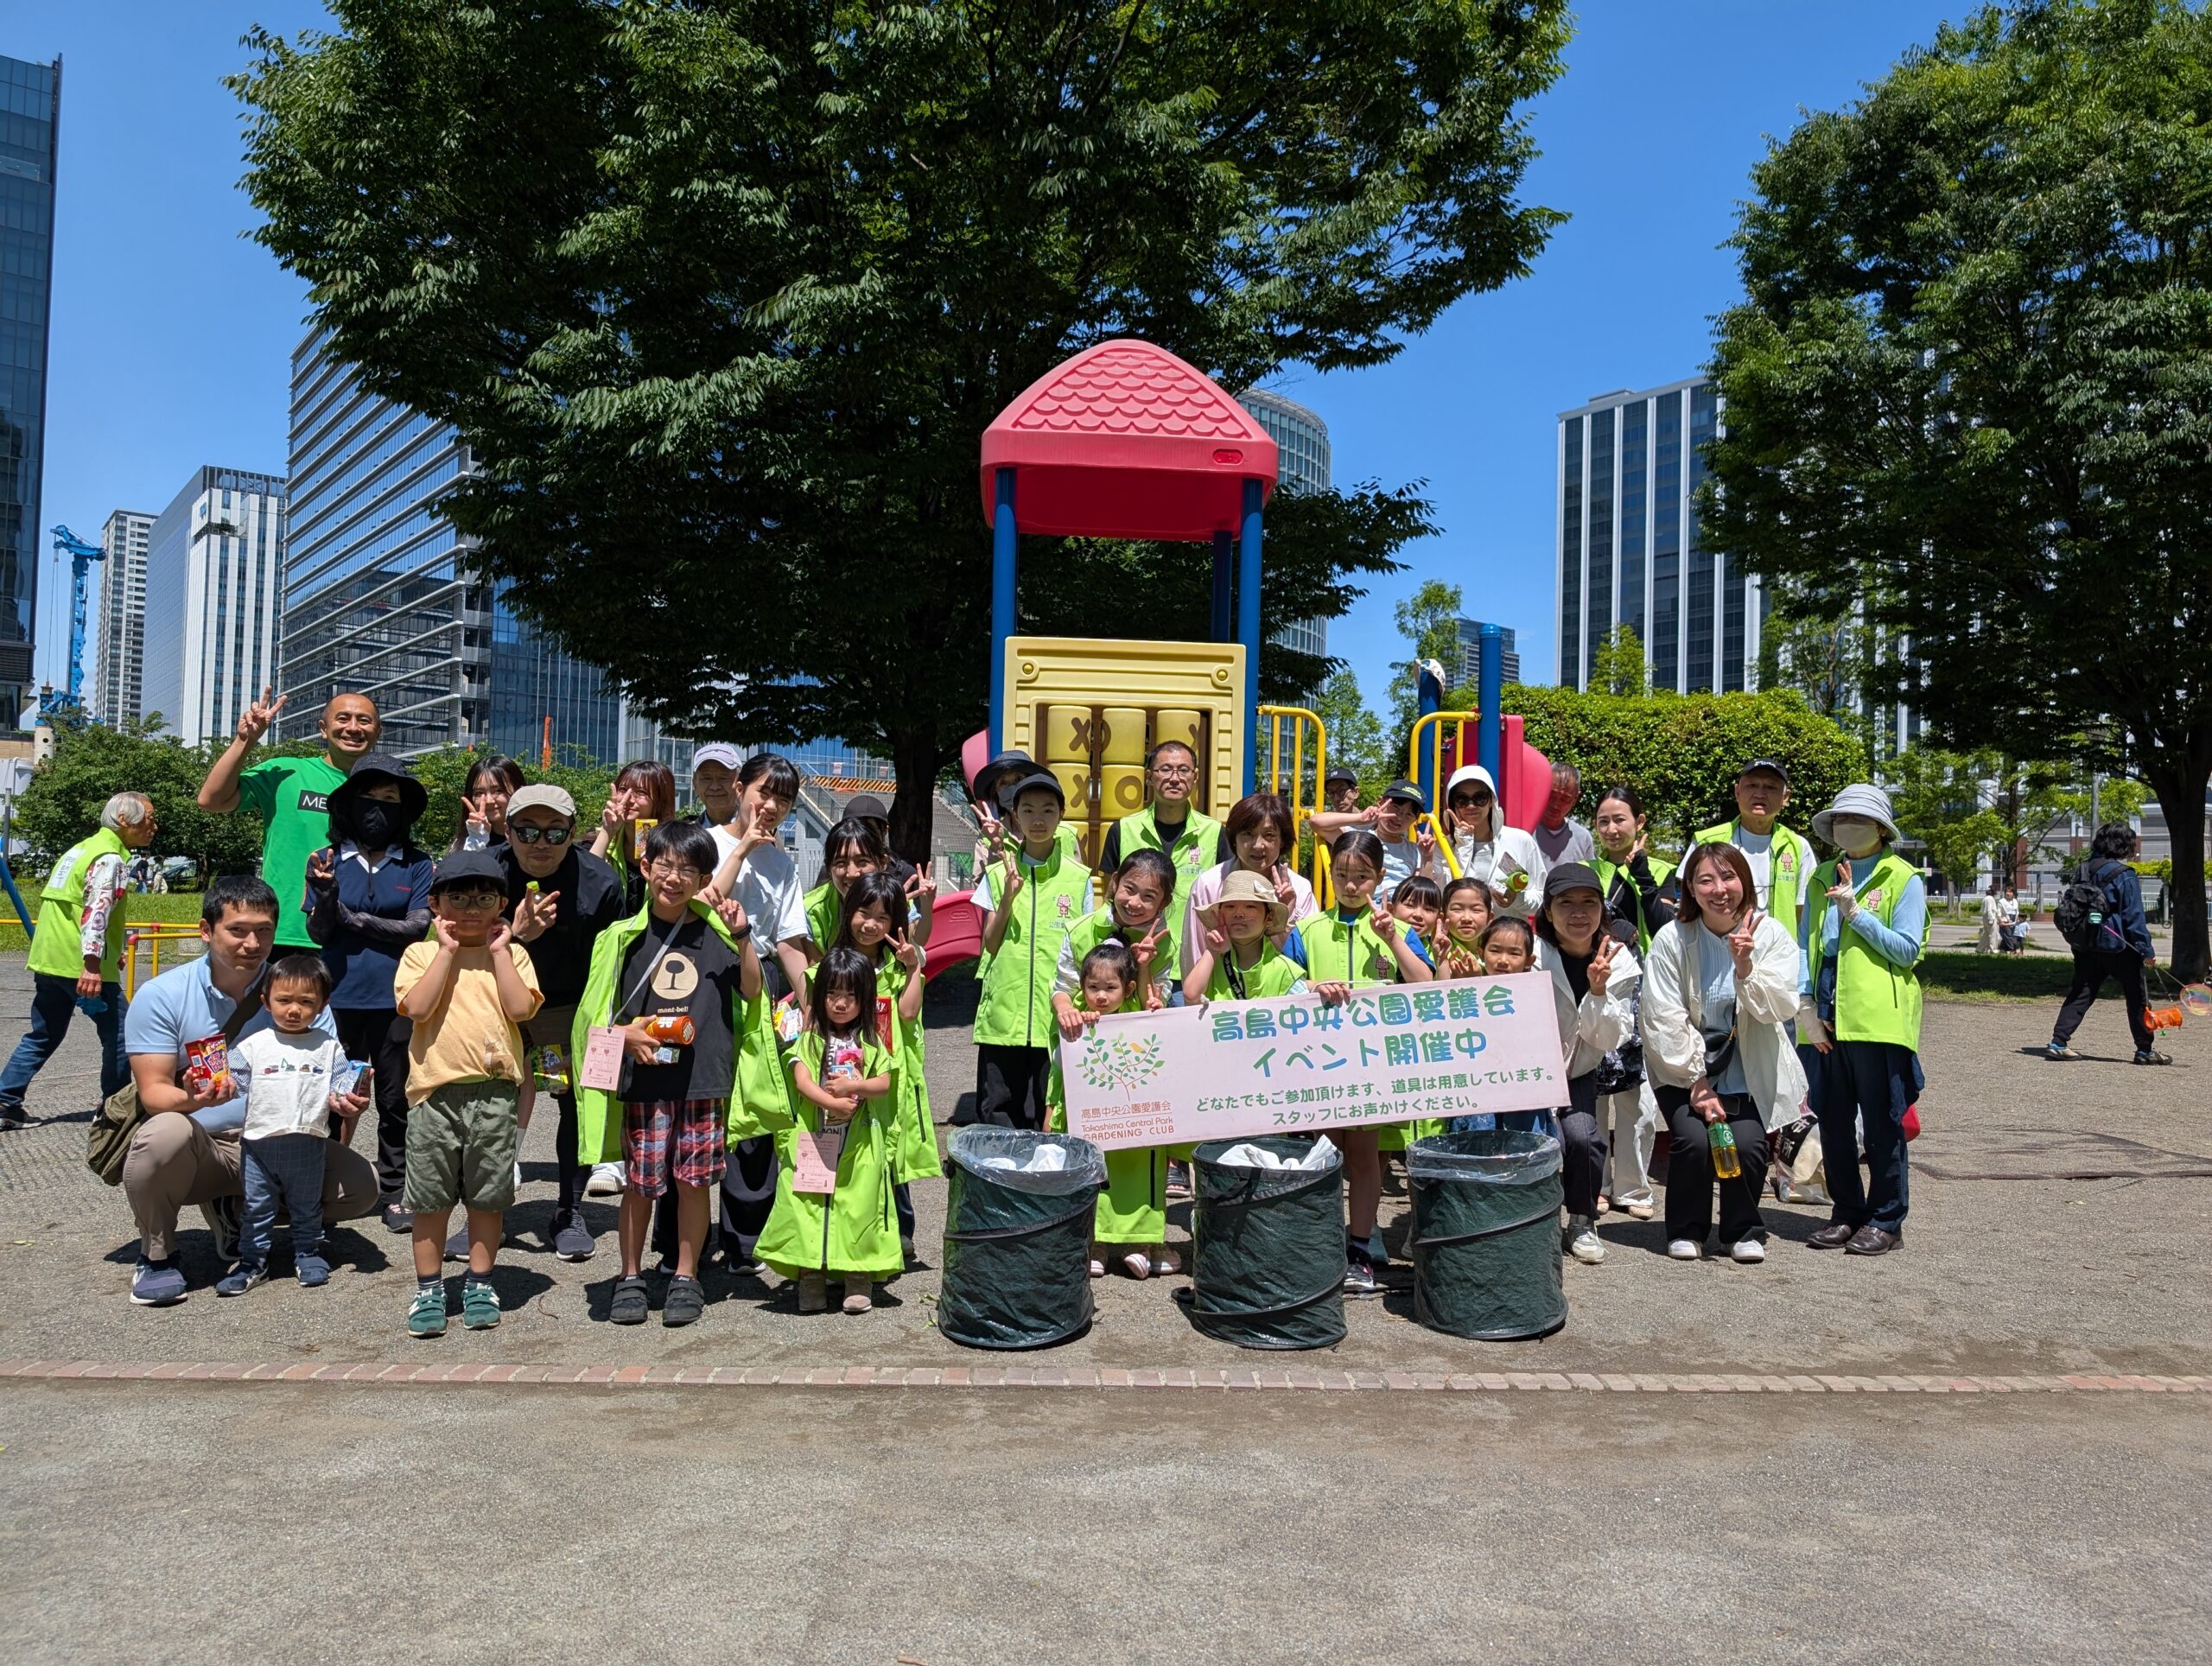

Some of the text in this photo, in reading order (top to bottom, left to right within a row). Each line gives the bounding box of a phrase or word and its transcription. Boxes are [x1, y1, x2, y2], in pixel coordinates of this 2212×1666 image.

[1211, 984, 1516, 1043] 高島中央公園愛護会
[1253, 1027, 1487, 1078] イベント開催中
[1196, 1065, 1554, 1113] どなたでもご参加頂けます、道具は用意しています。
[1081, 1100, 1172, 1120] 高島中央公園愛護会
[1082, 1116, 1173, 1133] Takashima Central Park
[1272, 1094, 1480, 1126] スタッフにお声かけください。
[1084, 1126, 1175, 1141] GARDENING CLUB
